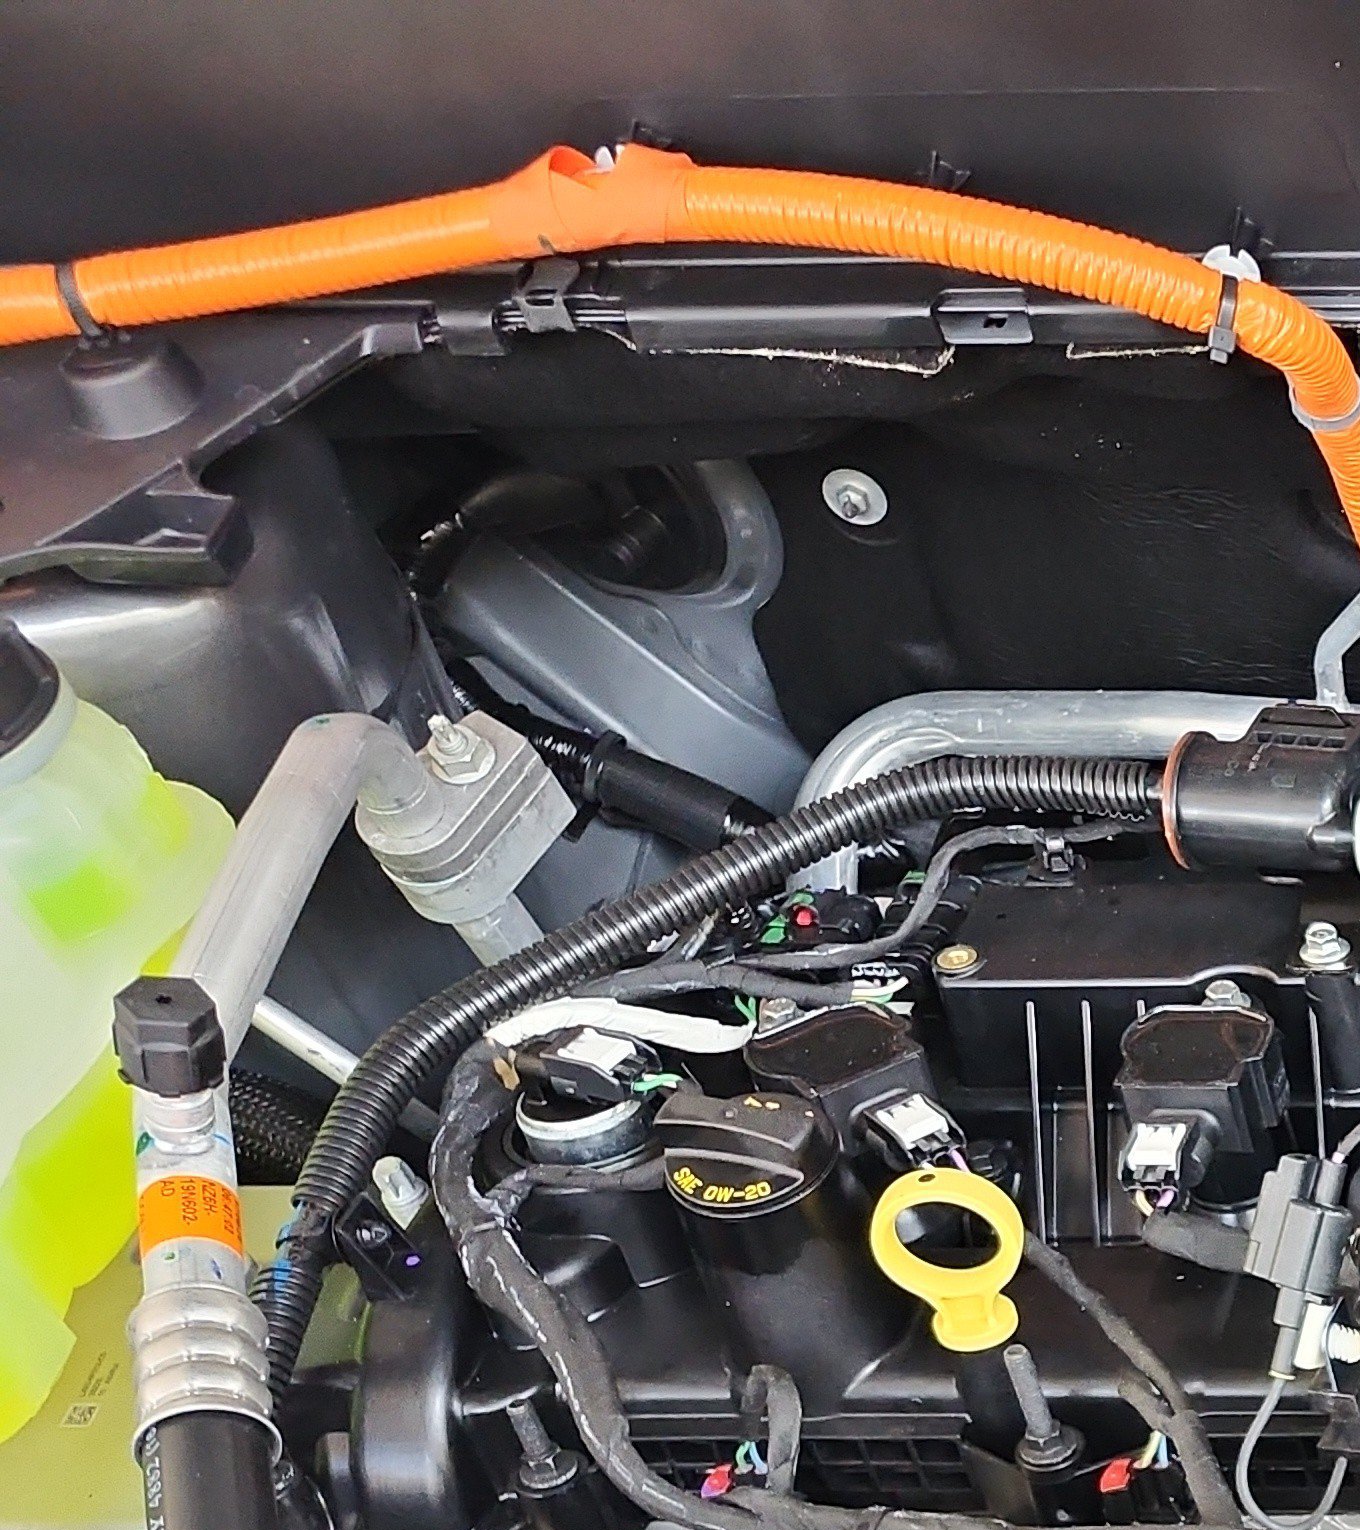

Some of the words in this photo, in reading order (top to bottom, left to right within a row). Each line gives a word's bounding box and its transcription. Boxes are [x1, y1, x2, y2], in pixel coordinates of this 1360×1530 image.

[160, 1180, 175, 1197] AD
[673, 1166, 703, 1196] SAE
[702, 1181, 772, 1203] 0W-20
